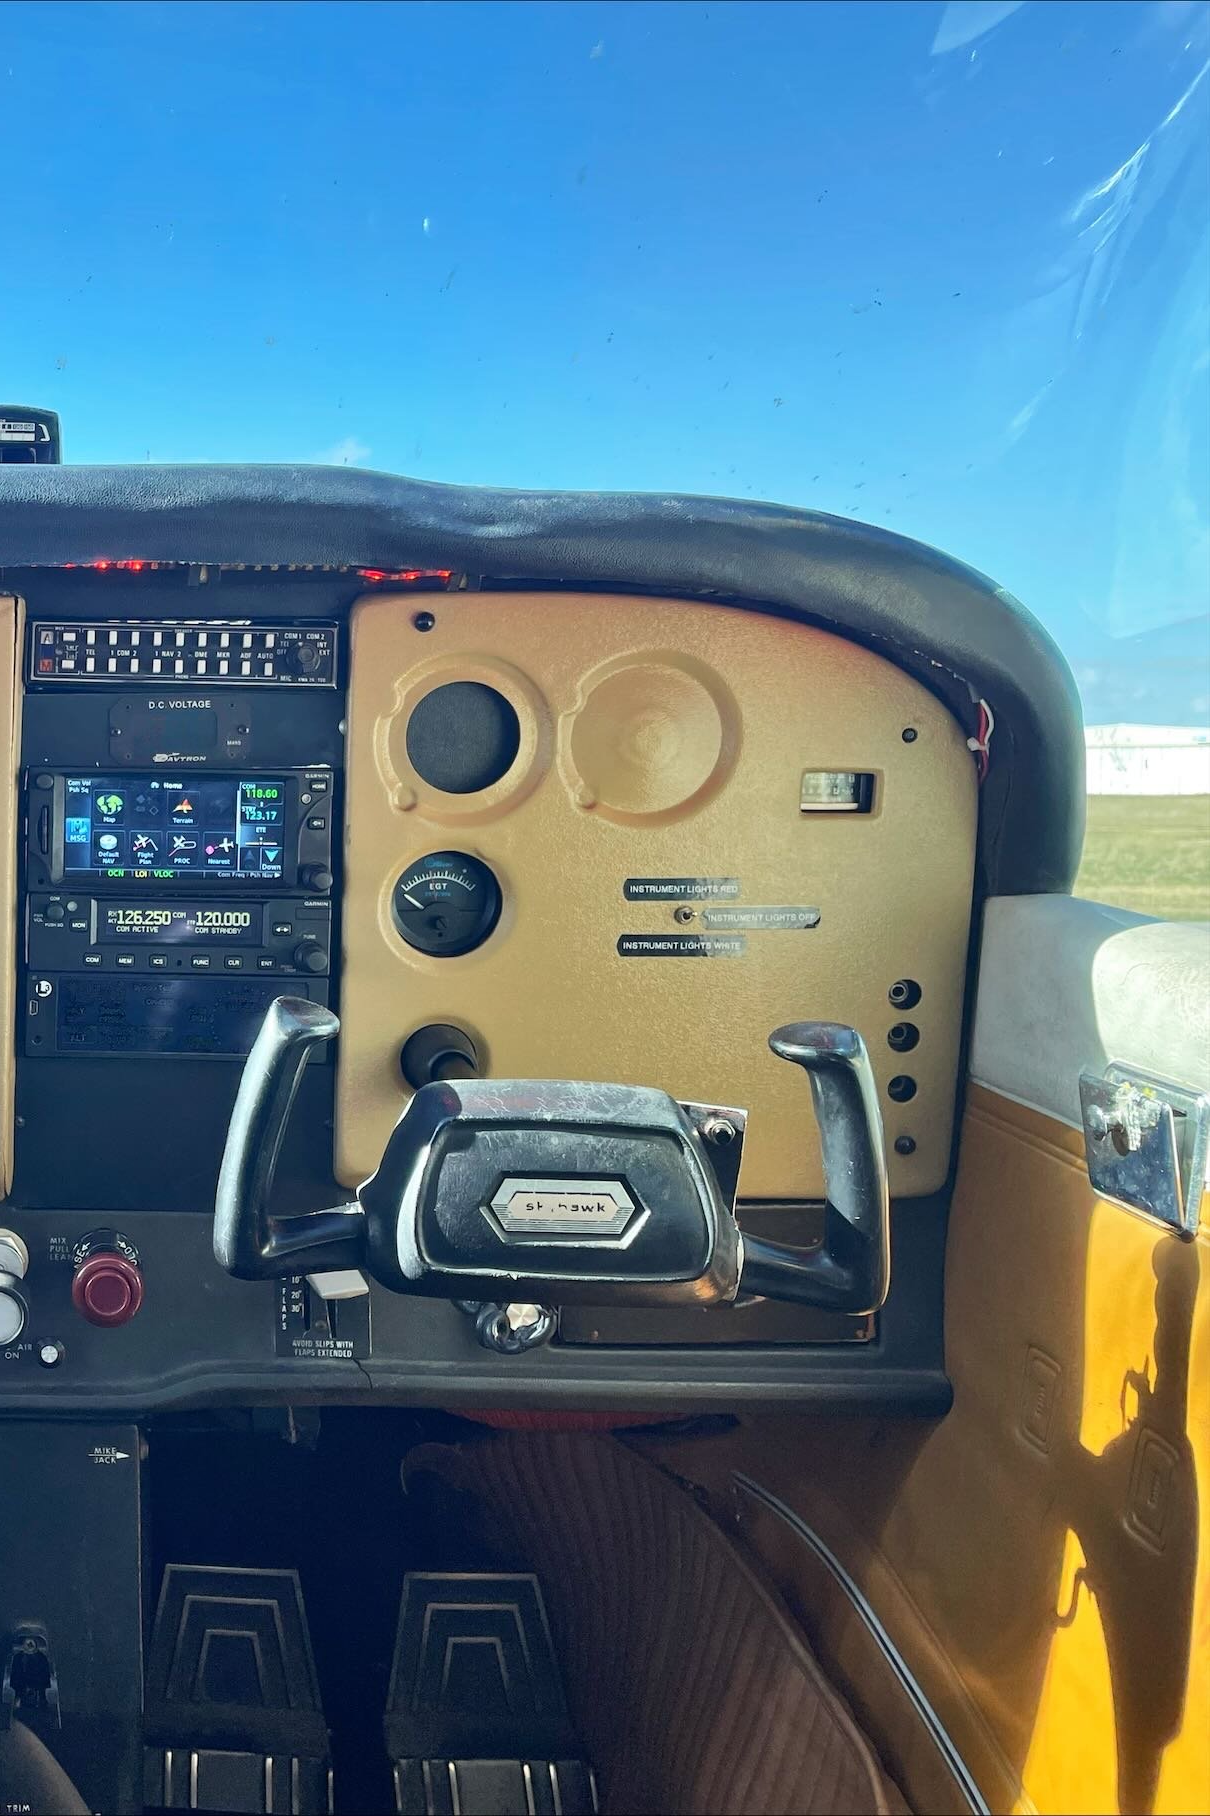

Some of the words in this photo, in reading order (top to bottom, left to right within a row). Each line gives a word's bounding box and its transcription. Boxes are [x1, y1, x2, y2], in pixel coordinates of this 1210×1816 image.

[170, 700, 211, 709] VOLTAGE
[246, 789, 277, 798] 118.60
[246, 812, 277, 820] 123.17
[117, 910, 171, 925] 126.250
[196, 912, 250, 926] 120.000
